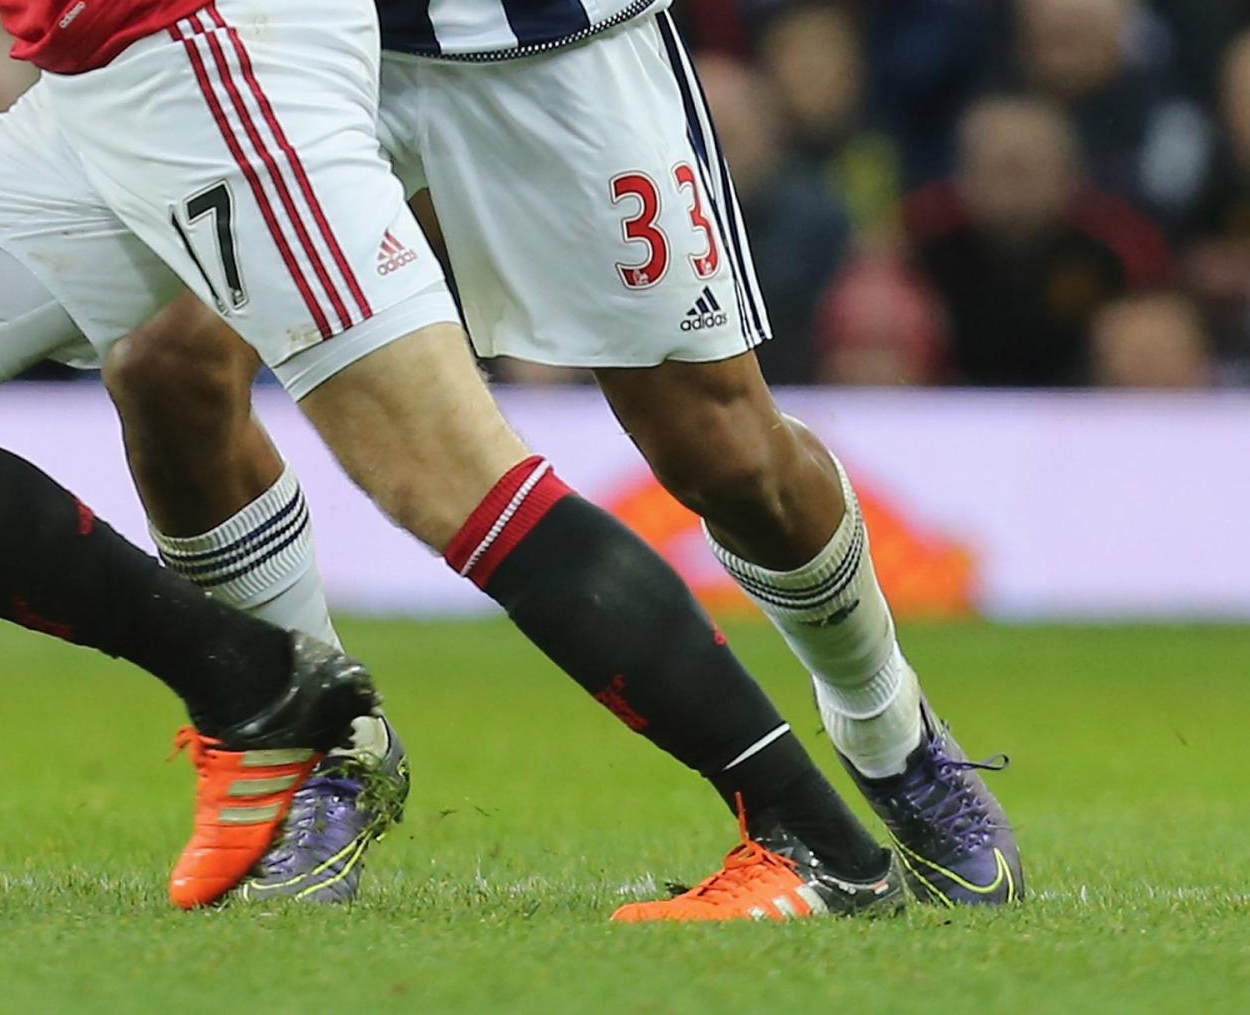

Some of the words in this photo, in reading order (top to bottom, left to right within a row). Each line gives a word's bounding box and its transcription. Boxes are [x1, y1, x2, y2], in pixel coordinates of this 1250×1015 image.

[609, 160, 721, 290] 33
[377, 249, 418, 276] adidas
[680, 313, 728, 332] adidas
